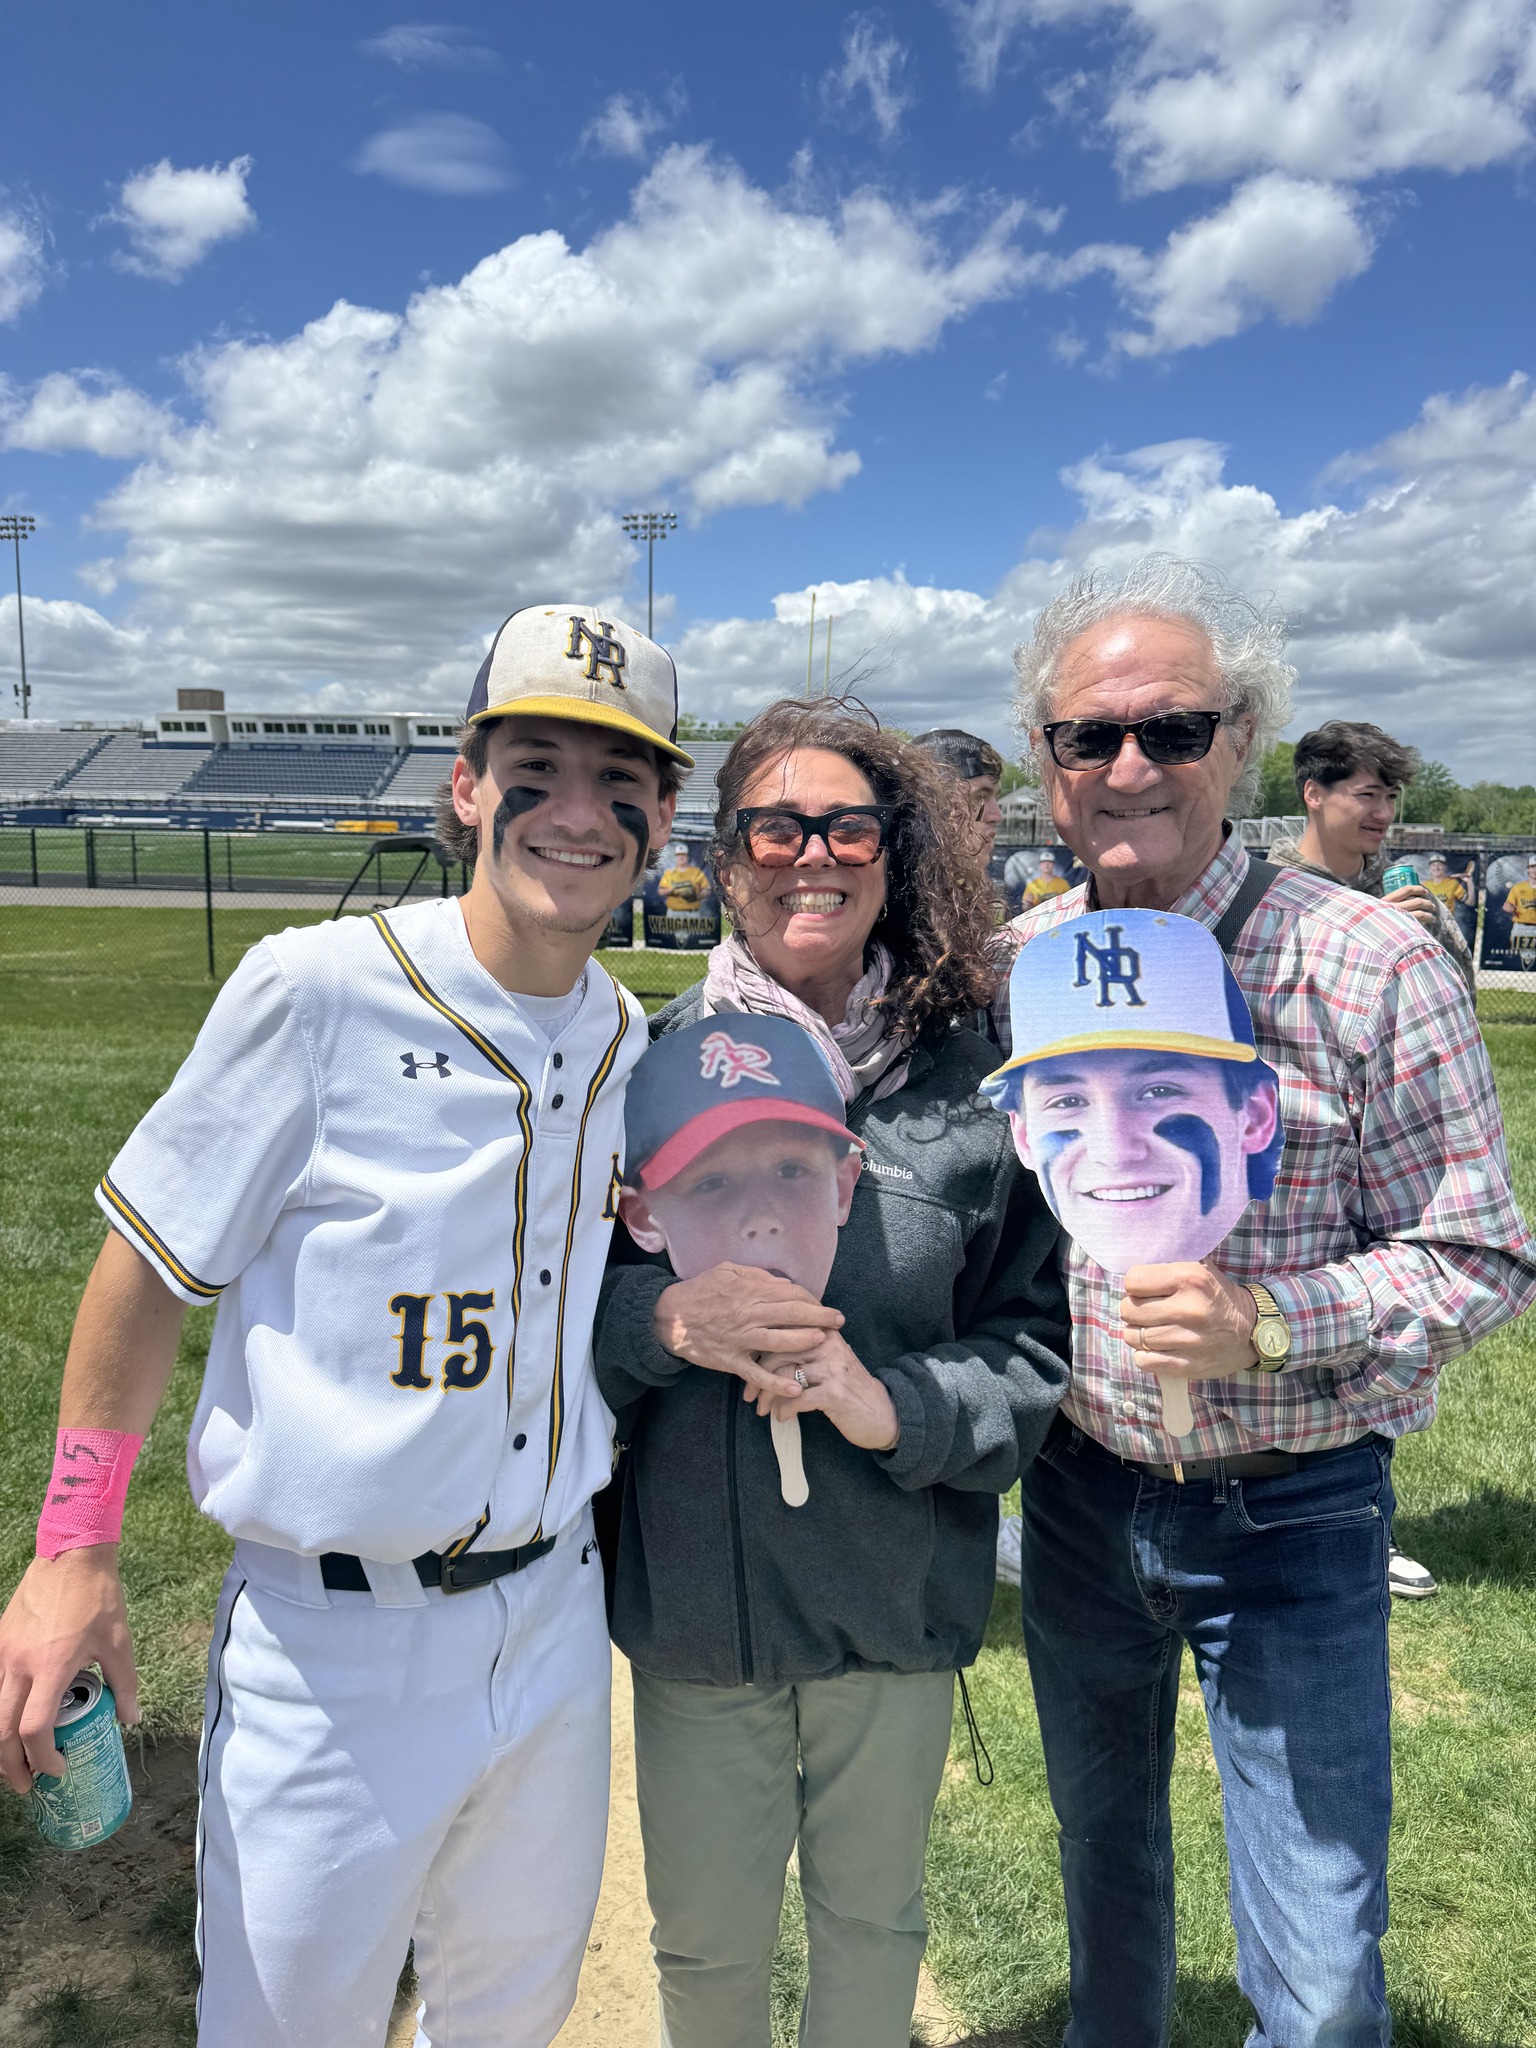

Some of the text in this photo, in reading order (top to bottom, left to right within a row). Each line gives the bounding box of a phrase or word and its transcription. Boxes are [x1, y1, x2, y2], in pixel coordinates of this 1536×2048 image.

[563, 615, 627, 690] NR
[647, 914, 716, 932] WAUGAMAN
[1072, 925, 1147, 1007] NR
[861, 1159, 913, 1180] olumbia
[388, 1289, 497, 1394] 15
[66, 1729, 97, 1748] Nutrition
[70, 1749, 98, 1766] Calories
